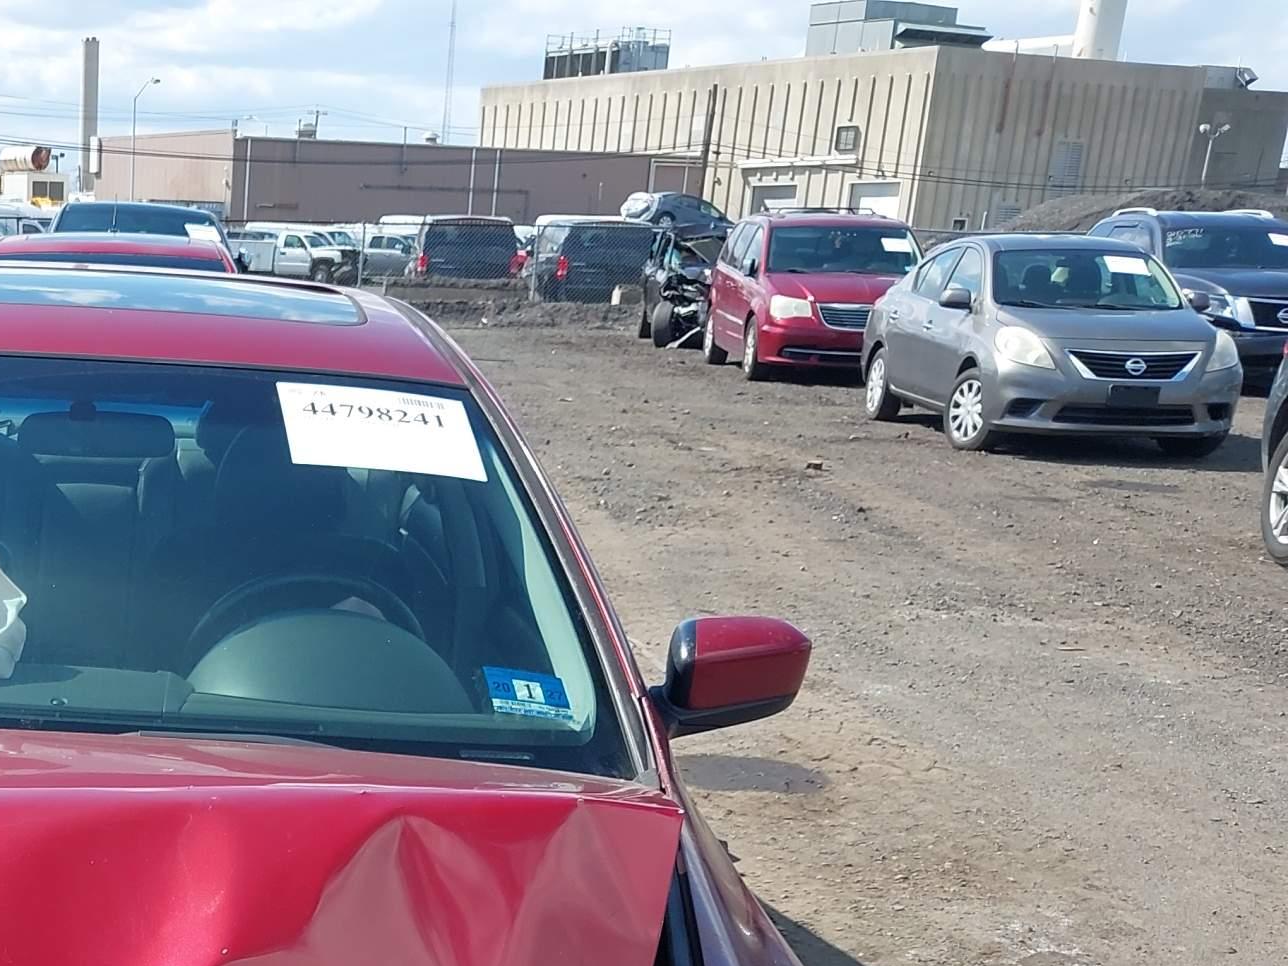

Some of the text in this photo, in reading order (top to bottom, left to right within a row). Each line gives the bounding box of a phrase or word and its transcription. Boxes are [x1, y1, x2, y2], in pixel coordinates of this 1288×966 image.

[302, 402, 444, 428] 44798241
[492, 680, 511, 693] 20
[523, 683, 536, 700] 1
